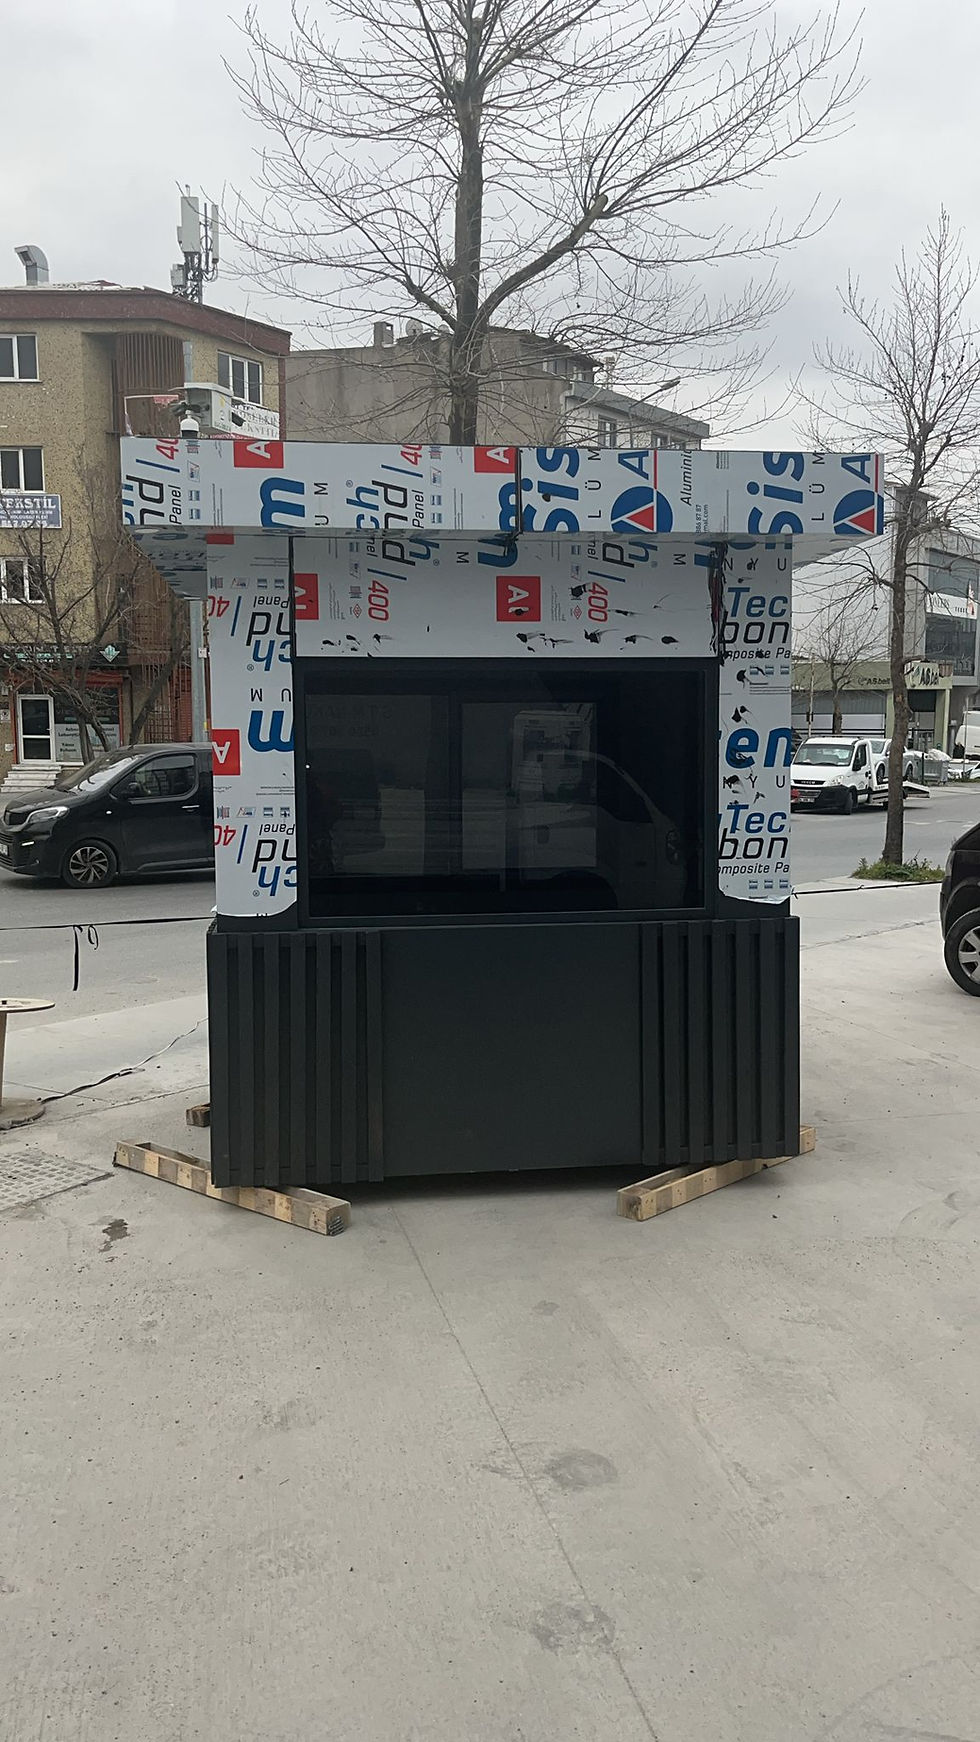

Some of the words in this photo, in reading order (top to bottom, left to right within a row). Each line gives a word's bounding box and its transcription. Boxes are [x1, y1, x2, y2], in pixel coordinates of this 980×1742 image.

[169, 484, 182, 525] Panel
[411, 489, 424, 528] Panel
[253, 596, 289, 608] Panel
[367, 580, 389, 622] 400
[587, 582, 608, 622] 400
[727, 587, 788, 617] Tec
[259, 823, 295, 836] Panel
[727, 804, 787, 833] Tec
